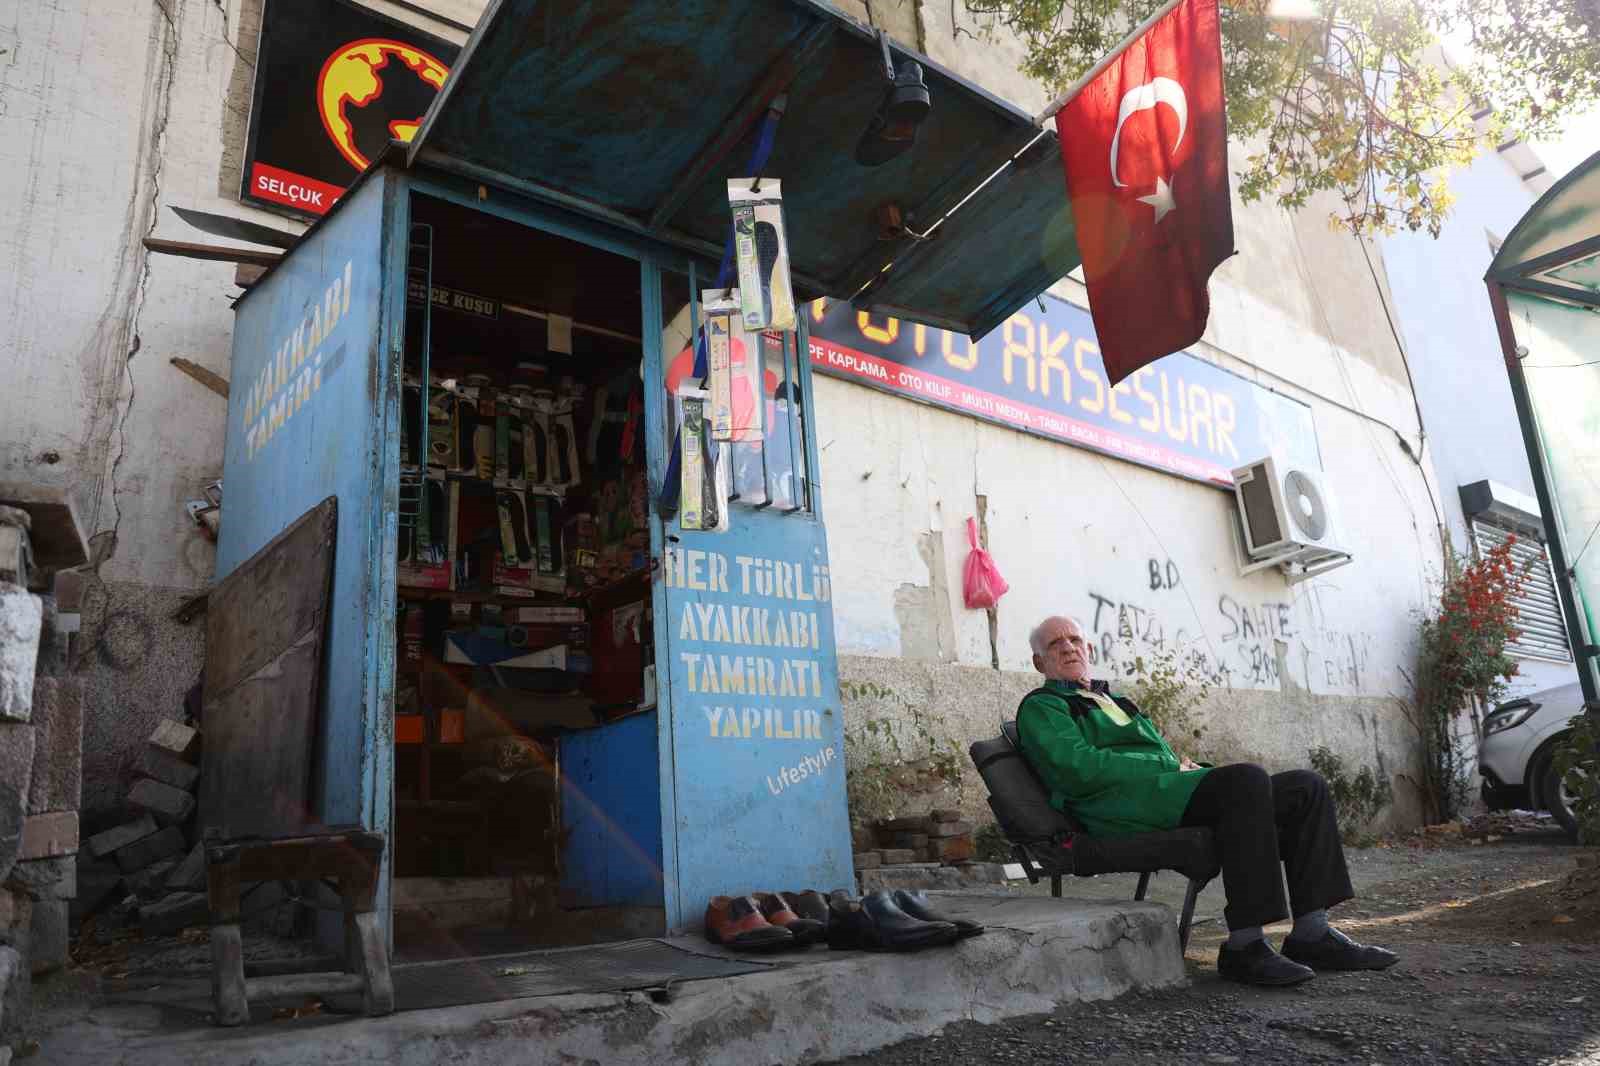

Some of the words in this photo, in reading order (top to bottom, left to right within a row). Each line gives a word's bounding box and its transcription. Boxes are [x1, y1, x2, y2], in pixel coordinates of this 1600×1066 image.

[258, 175, 323, 206] SELÇUK
[828, 349, 889, 380] KAPLAMA
[899, 372, 922, 390] OTO
[664, 547, 729, 592] HER
[735, 556, 831, 602] TÜRLÜ
[679, 602, 820, 650] AYAKKABI
[1219, 593, 1293, 642] SAHTE
[680, 652, 821, 698] TAMİRATI
[703, 705, 822, 740] YAPILIR
[767, 745, 837, 795] Lifestyle
